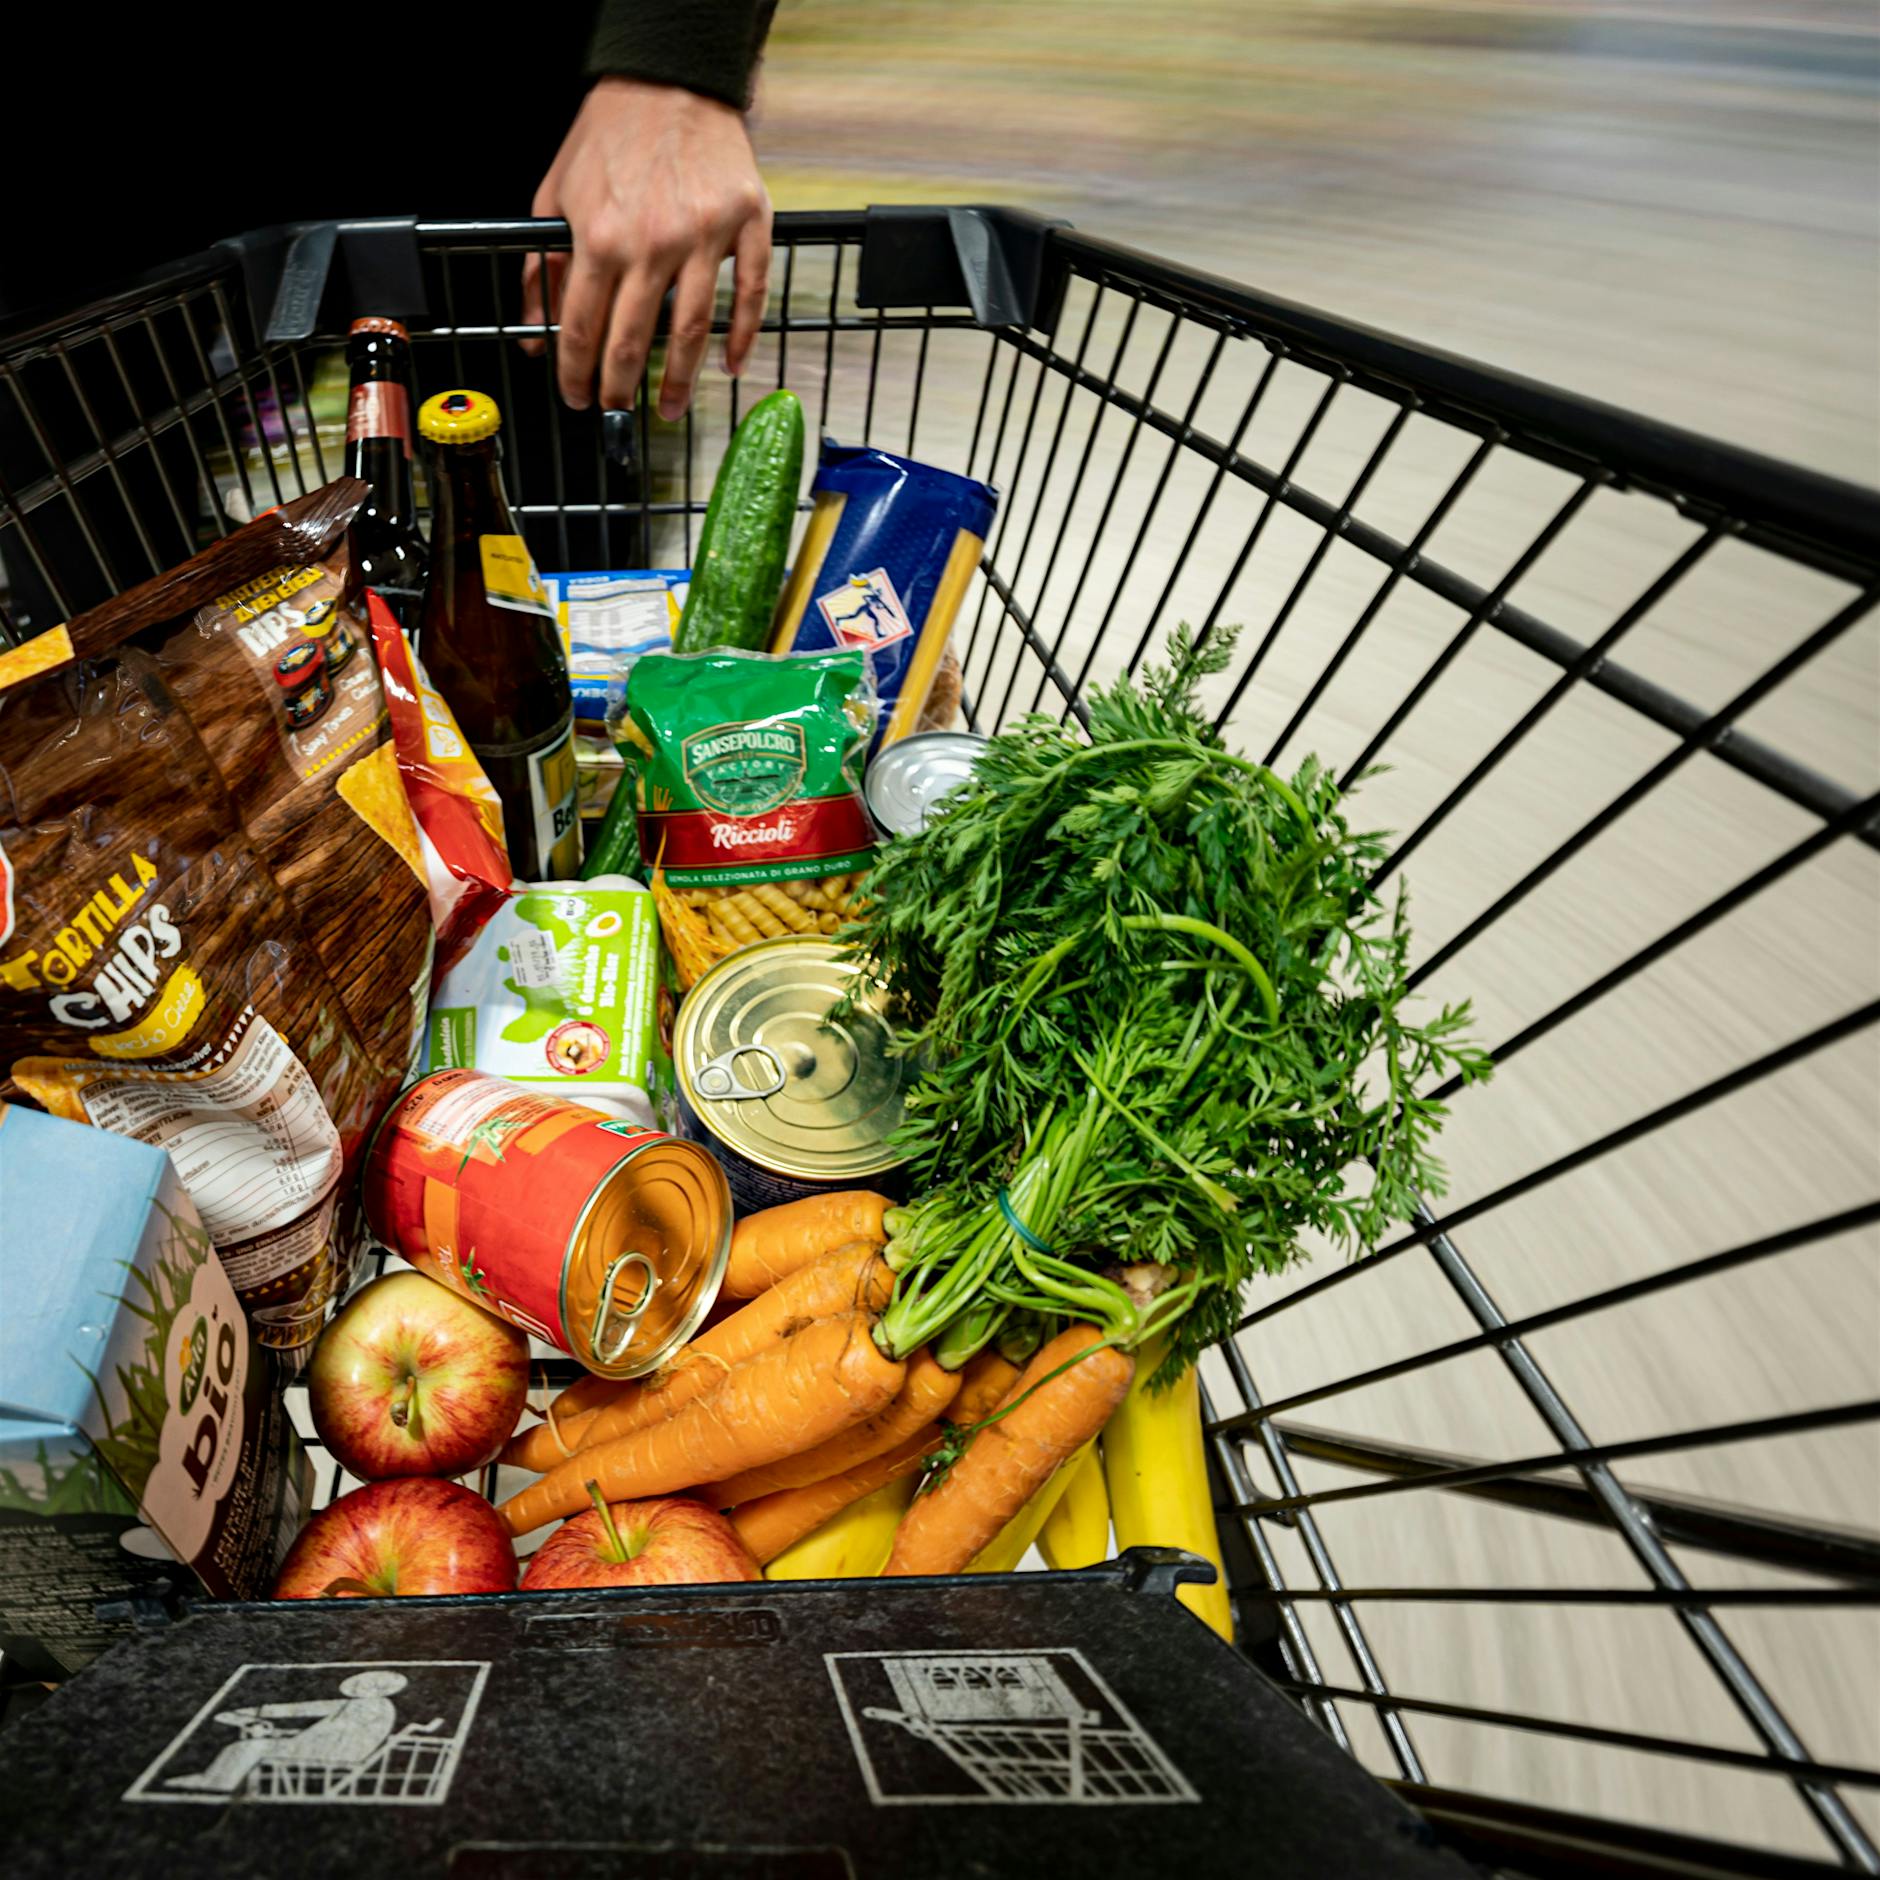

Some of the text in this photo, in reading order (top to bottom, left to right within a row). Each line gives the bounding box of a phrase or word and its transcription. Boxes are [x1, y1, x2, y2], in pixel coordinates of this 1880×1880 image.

[692, 732, 795, 765] SANSEPOLCRO
[711, 818, 793, 850] Riccioli
[702, 870, 768, 882] SELEZIONATA
[771, 869, 782, 878] DI
[784, 865, 821, 877] GRANO
[824, 860, 851, 872] DURO
[0, 851, 157, 991] TORTILLA
[48, 903, 182, 1029] CHIPS
[185, 1331, 205, 1402] Arla
[183, 1322, 236, 1497] bio
